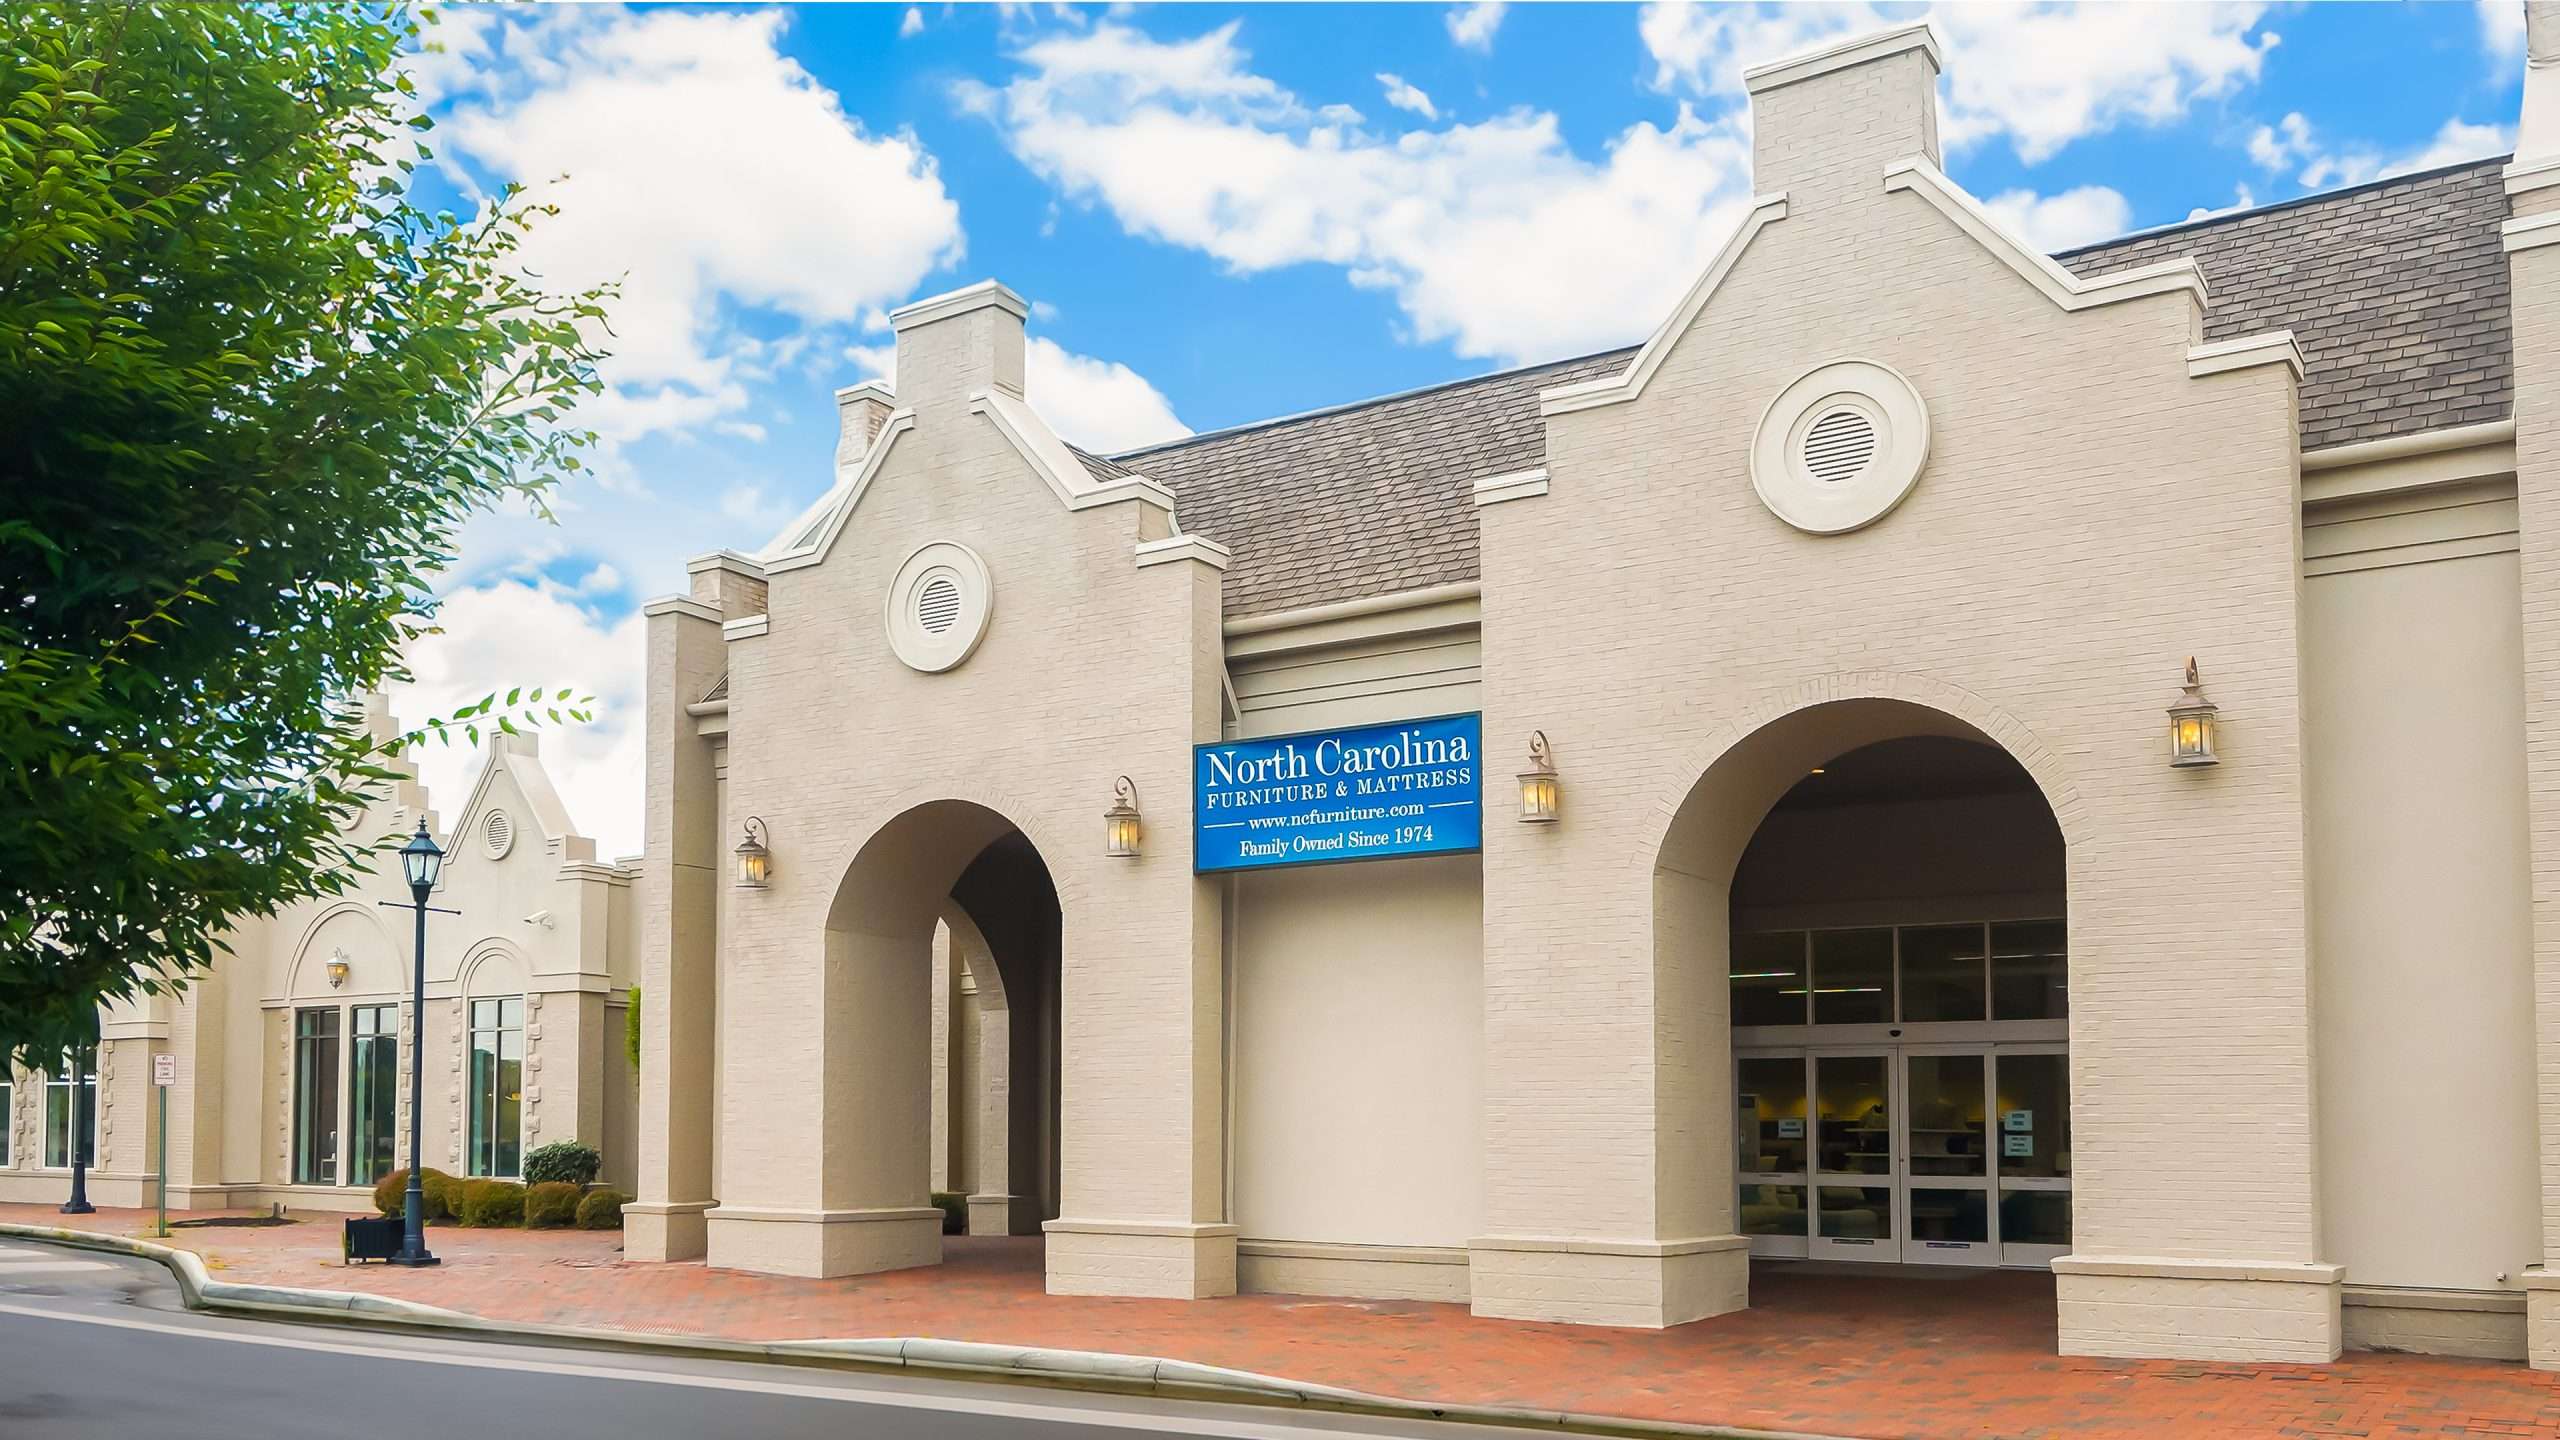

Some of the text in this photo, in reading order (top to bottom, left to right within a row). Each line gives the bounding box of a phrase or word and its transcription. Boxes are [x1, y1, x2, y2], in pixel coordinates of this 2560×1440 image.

[1206, 730, 1470, 787] North Carolina
[1206, 767, 1471, 809] FURNITURE & MATTRESS
[1248, 802, 1424, 830] www.ncfurniture.com
[1239, 825, 1433, 858] Family Owned Since 1974
